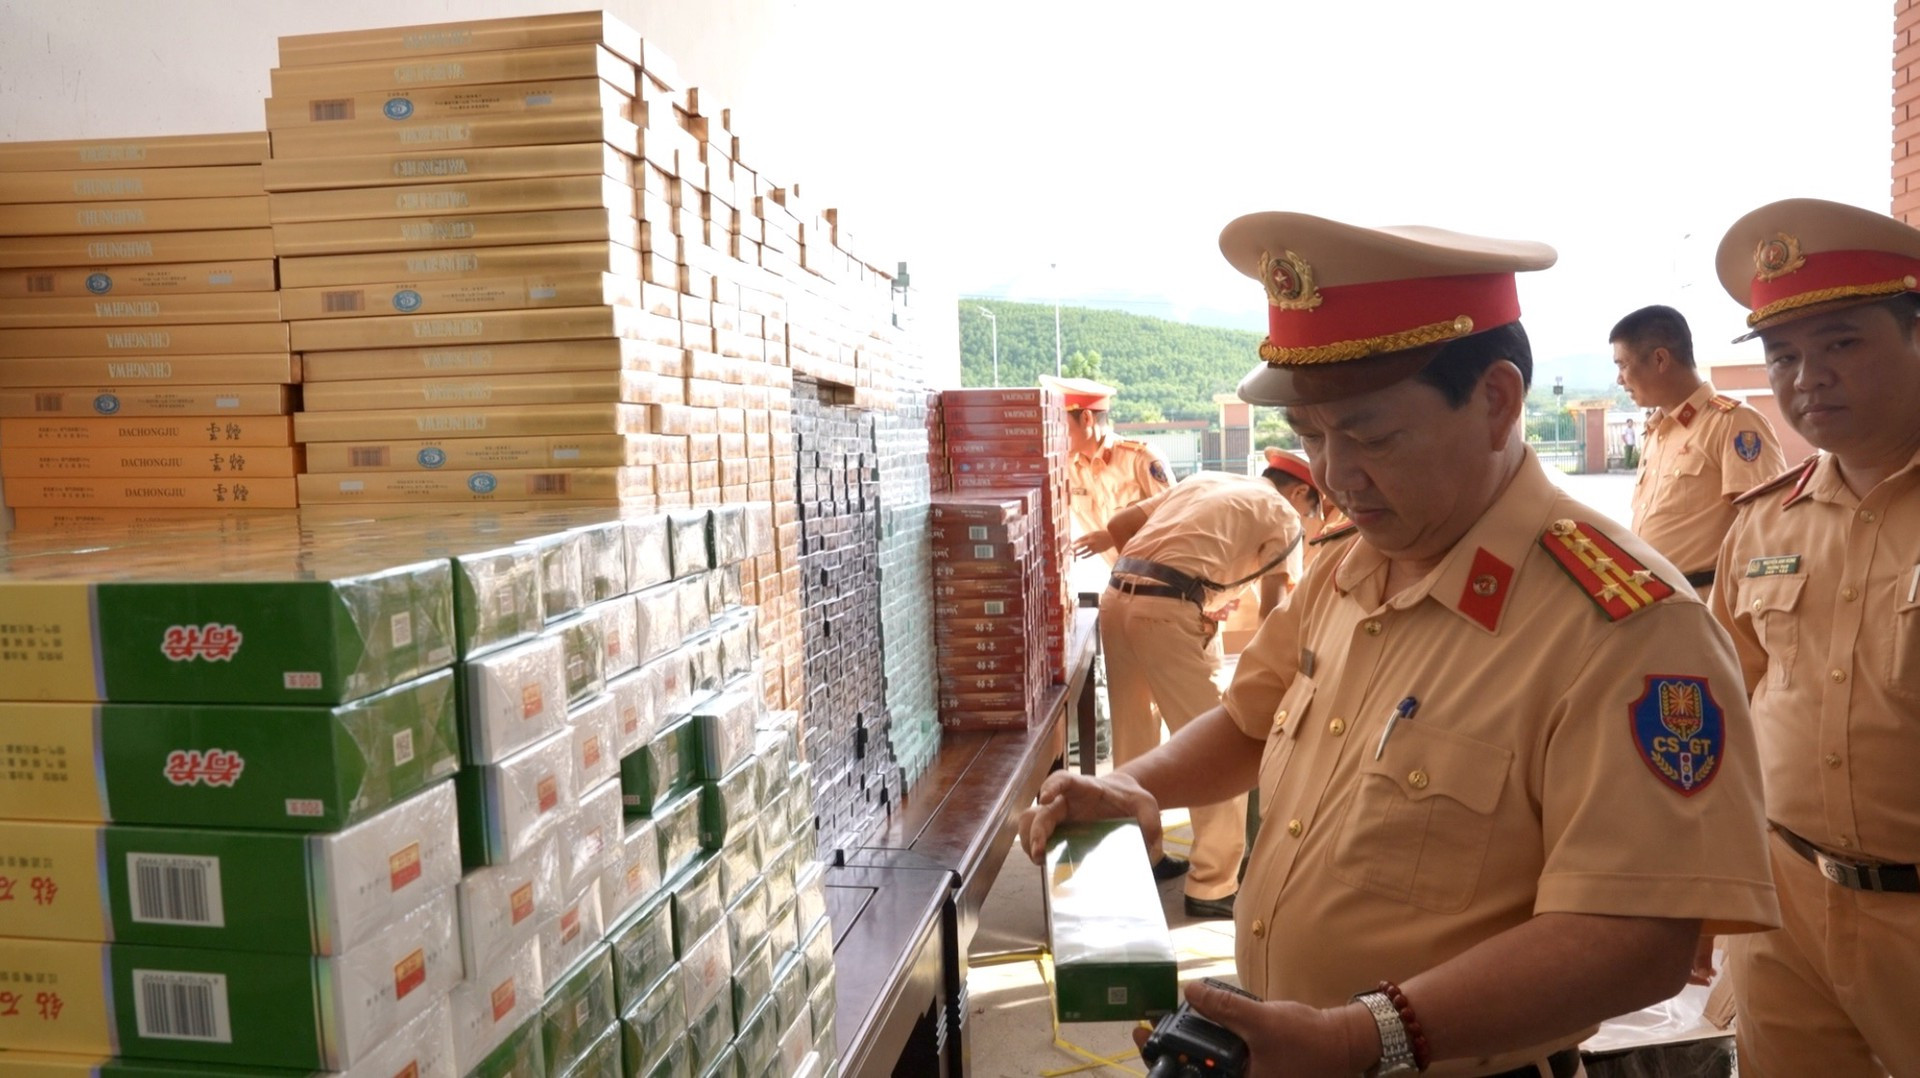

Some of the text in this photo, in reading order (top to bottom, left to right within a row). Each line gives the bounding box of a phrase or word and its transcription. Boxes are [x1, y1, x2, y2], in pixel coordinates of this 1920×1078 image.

[88, 240, 154, 258] CHUNGHWA
[94, 300, 160, 318] CHUNGHWA
[106, 332, 170, 350] CHUNGHWA
[108, 361, 172, 379] CHUNGHWA
[119, 427, 180, 438] DACHONGJIU
[121, 457, 183, 468] DACHONGJIU
[125, 487, 186, 499] DACHONGJIU
[162, 622, 244, 662] 荷花
[1653, 736, 1711, 755] CS GT
[164, 748, 245, 788] 荷花
